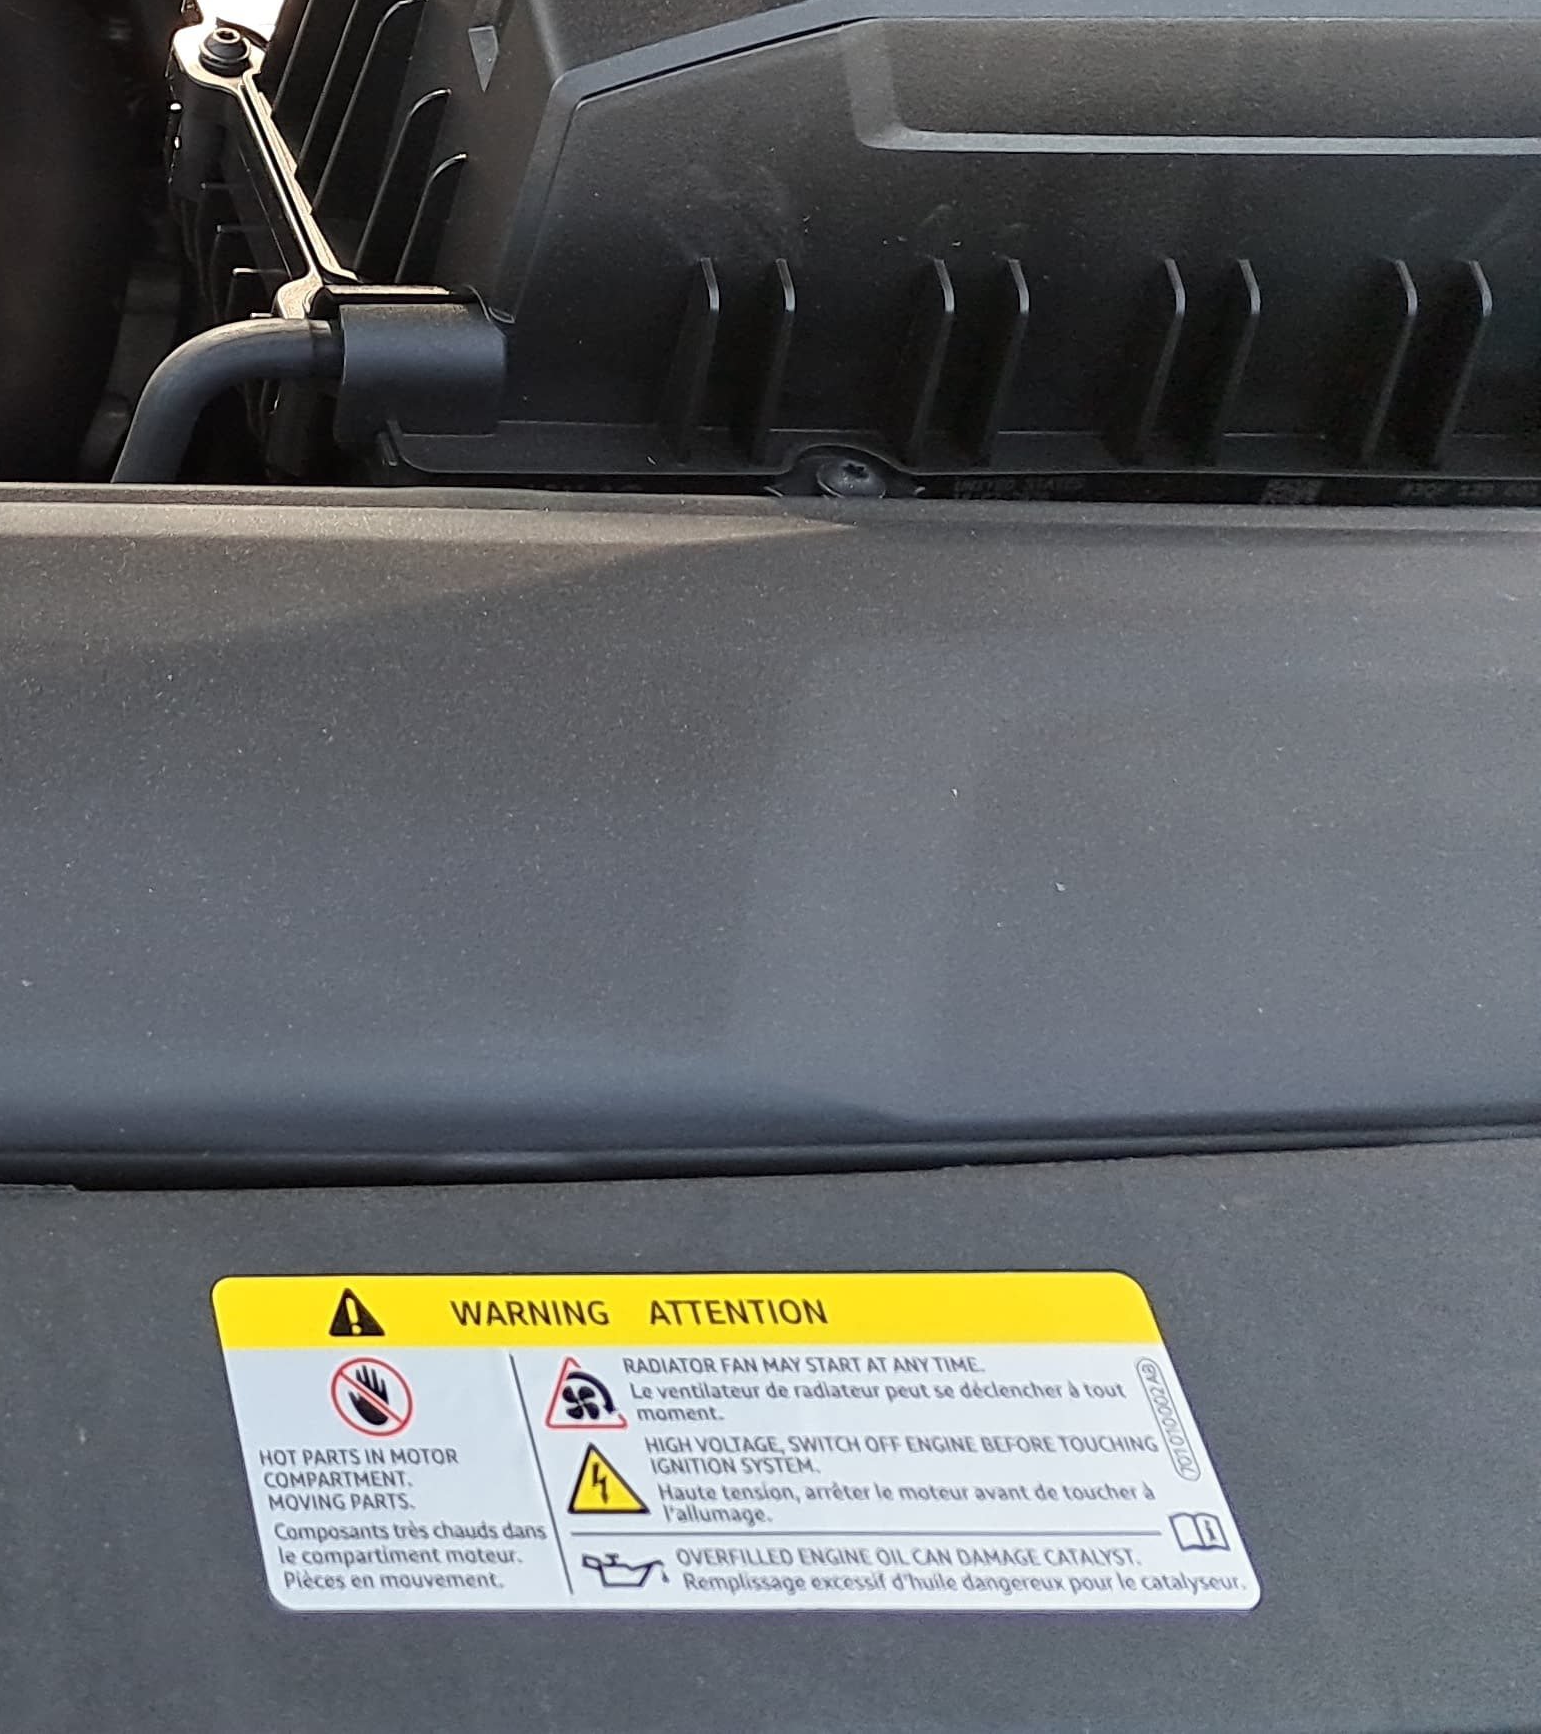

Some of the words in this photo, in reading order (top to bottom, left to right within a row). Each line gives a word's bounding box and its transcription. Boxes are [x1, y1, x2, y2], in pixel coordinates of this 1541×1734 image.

[449, 1299, 610, 1327] WARNING
[649, 1298, 828, 1326] ATTENTION
[621, 1356, 718, 1374] RADIATOR
[719, 1356, 759, 1374] FAN
[761, 1356, 800, 1373] MAY
[804, 1355, 861, 1374] START
[866, 1356, 887, 1373] AT
[892, 1356, 929, 1373] ANY
[931, 1355, 985, 1373] TIME.
[628, 1381, 653, 1400] Le
[655, 1381, 760, 1400] ventilateur
[764, 1380, 789, 1399] de
[792, 1380, 880, 1399] radiateur
[883, 1383, 931, 1403] peut
[932, 1384, 955, 1399] se
[958, 1380, 1062, 1399] déclencher
[1082, 1383, 1127, 1399] tout
[635, 1405, 725, 1422] moment.
[643, 1435, 693, 1454] HIGH
[693, 1434, 786, 1455] VOLTAGE,
[786, 1434, 862, 1453] SWITCH
[863, 1434, 900, 1453] OFF
[903, 1434, 978, 1454] ENGINE
[979, 1435, 1056, 1453] BEFORE
[1056, 1434, 1159, 1453] TOUCHING
[258, 1448, 296, 1466] HOT
[301, 1447, 361, 1466] PARTS
[363, 1447, 386, 1465] IN
[388, 1447, 459, 1465] MOTOR
[649, 1456, 737, 1475] IGNITION
[739, 1455, 820, 1475] SYSTEM.
[262, 1469, 412, 1489] COMPARTMENT.
[267, 1492, 346, 1512] MOVING
[349, 1491, 415, 1510] PARTS.
[656, 1482, 718, 1502] Haute
[720, 1482, 801, 1504] tension,
[803, 1480, 870, 1501] arrêter
[872, 1482, 894, 1501] le
[897, 1484, 968, 1501] moteur
[973, 1484, 1030, 1501] avant
[1033, 1482, 1058, 1501] de
[1061, 1482, 1137, 1501] toucher
[661, 1503, 772, 1528] l'allumage.
[273, 1521, 390, 1542] Composants
[391, 1519, 430, 1540] très
[431, 1520, 500, 1540] chauds
[501, 1520, 548, 1540] dans
[277, 1545, 296, 1565] le
[300, 1545, 441, 1567] compartiment
[444, 1547, 523, 1564] moteur.
[674, 1546, 794, 1567] OVERFILLED
[795, 1546, 872, 1566] ENGINE
[874, 1547, 910, 1566] OIL
[910, 1547, 953, 1566] CAN
[955, 1547, 1041, 1566] DAMAGE
[1042, 1547, 1141, 1567] CATALYST.
[282, 1569, 347, 1590] Pièces
[349, 1574, 375, 1589] en
[378, 1571, 504, 1589] mouvement.
[681, 1570, 807, 1596] Remplissage
[809, 1571, 887, 1591] excessif
[890, 1571, 958, 1591] d'huile
[960, 1572, 1065, 1596] dangereux
[1067, 1576, 1113, 1595] pour
[1115, 1571, 1137, 1591] le
[1139, 1571, 1246, 1596] catalyseur.
